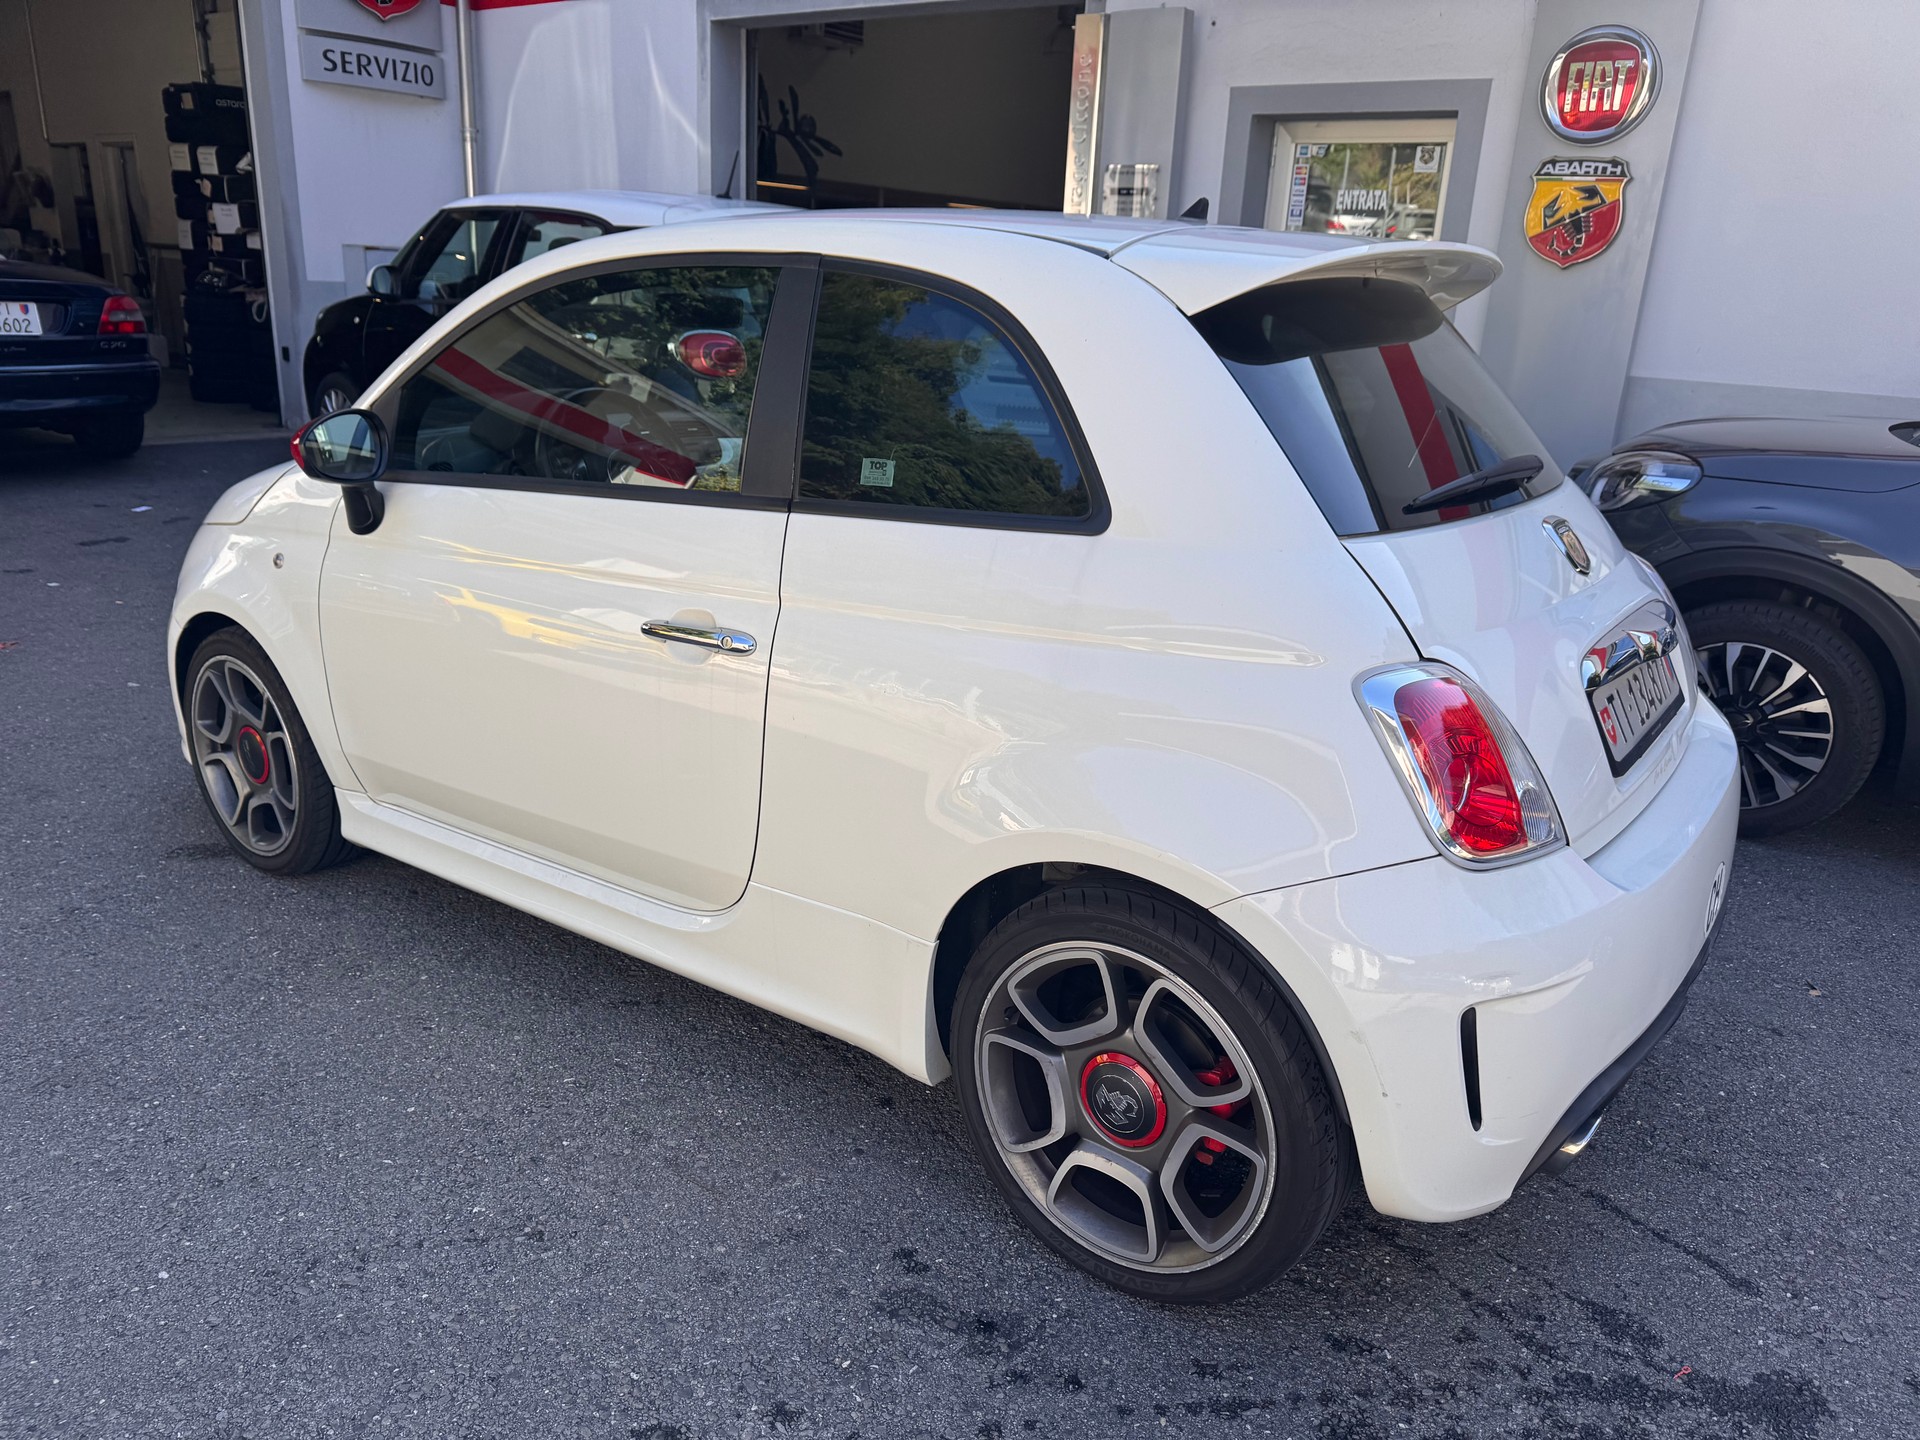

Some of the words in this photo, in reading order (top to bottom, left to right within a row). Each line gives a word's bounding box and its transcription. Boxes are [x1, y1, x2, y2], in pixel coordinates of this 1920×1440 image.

[322, 48, 434, 87] SERVIZIO
[1564, 60, 1634, 112] FIAT
[1540, 162, 1621, 175] ABARTH
[1335, 189, 1388, 211] ENTRATA
[0, 316, 33, 334] 602
[870, 461, 887, 470] TOP
[1705, 867, 1724, 934] CH
[1109, 926, 1171, 960] YOKOHAMA
